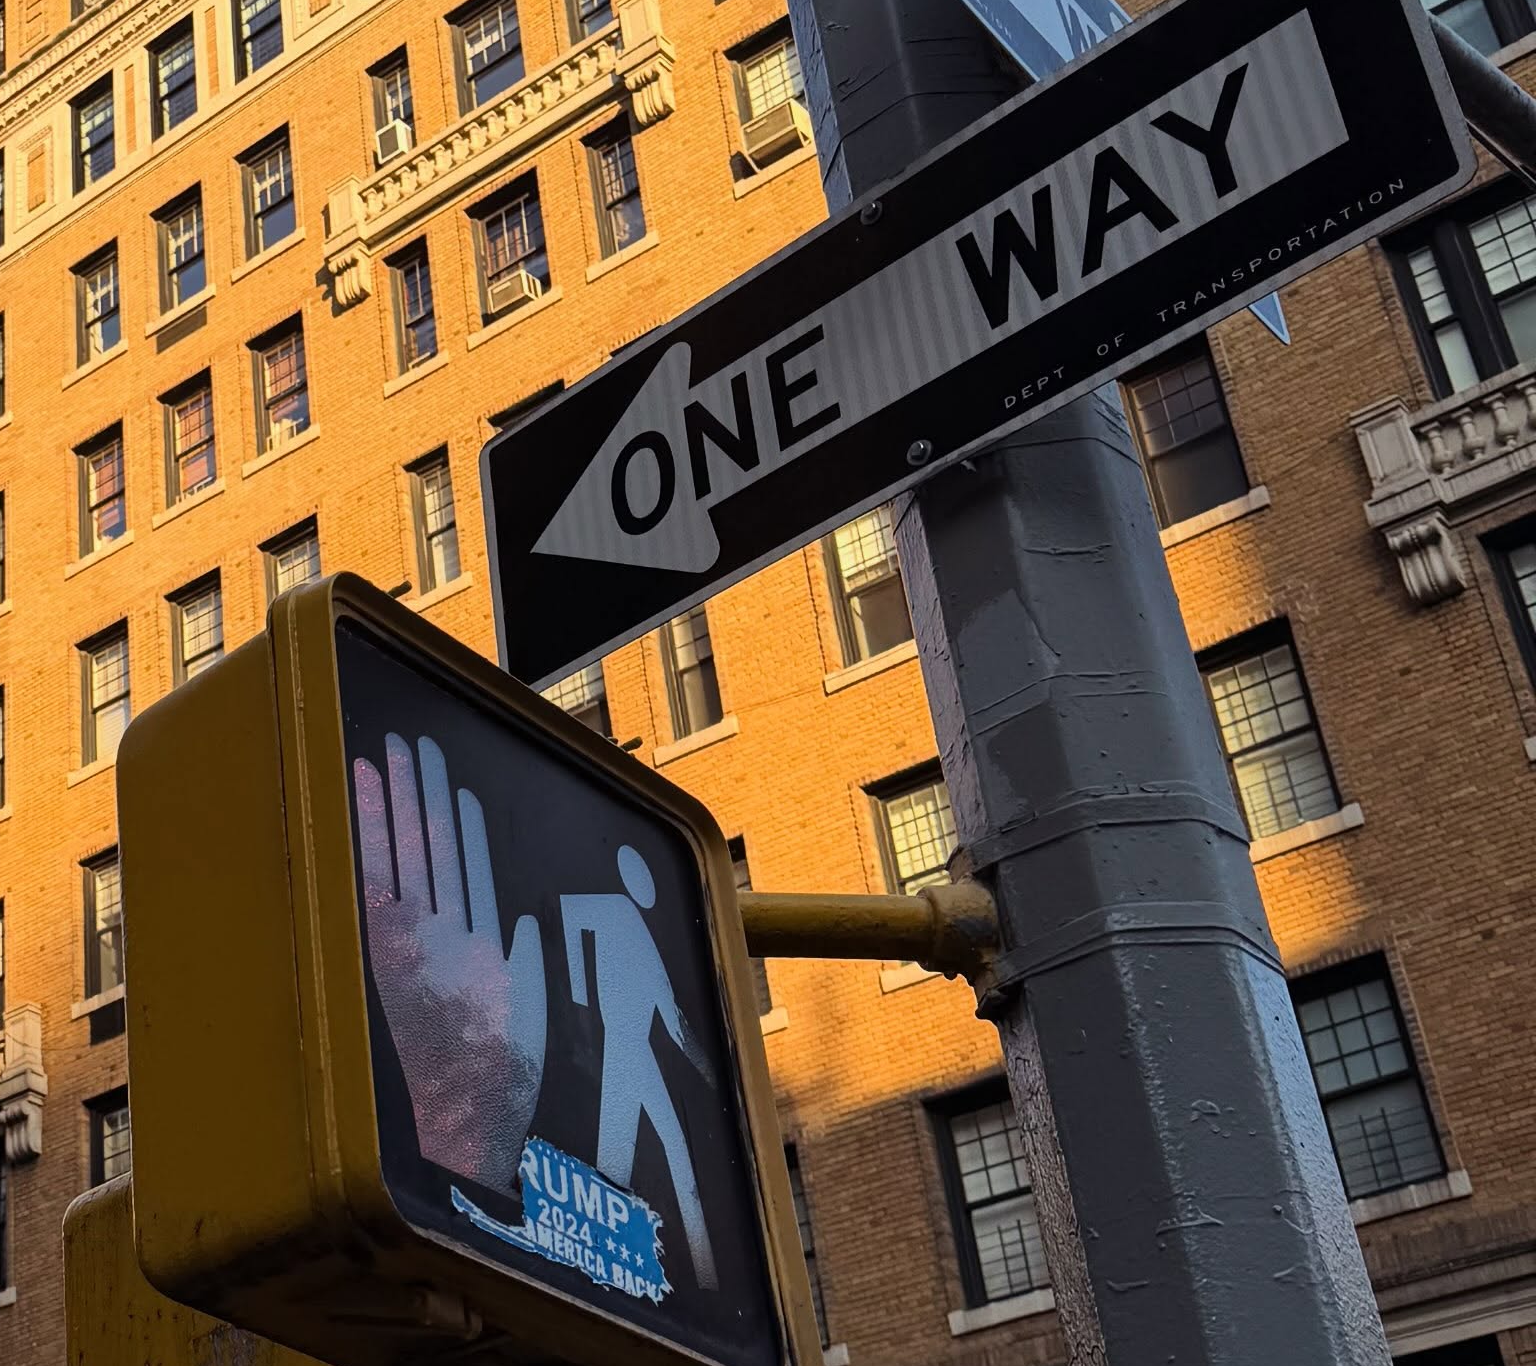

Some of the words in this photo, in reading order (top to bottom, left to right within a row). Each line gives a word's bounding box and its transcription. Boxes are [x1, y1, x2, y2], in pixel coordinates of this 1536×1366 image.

[610, 325, 842, 536] ONE
[956, 62, 1250, 331] WAY
[1004, 366, 1066, 409] DEPT
[1096, 333, 1126, 357] OF
[1157, 178, 1405, 323] TRANSPORTATION
[519, 1147, 630, 1233] RUMP
[537, 1198, 593, 1248] 2024
[523, 1215, 608, 1280] AMERICA
